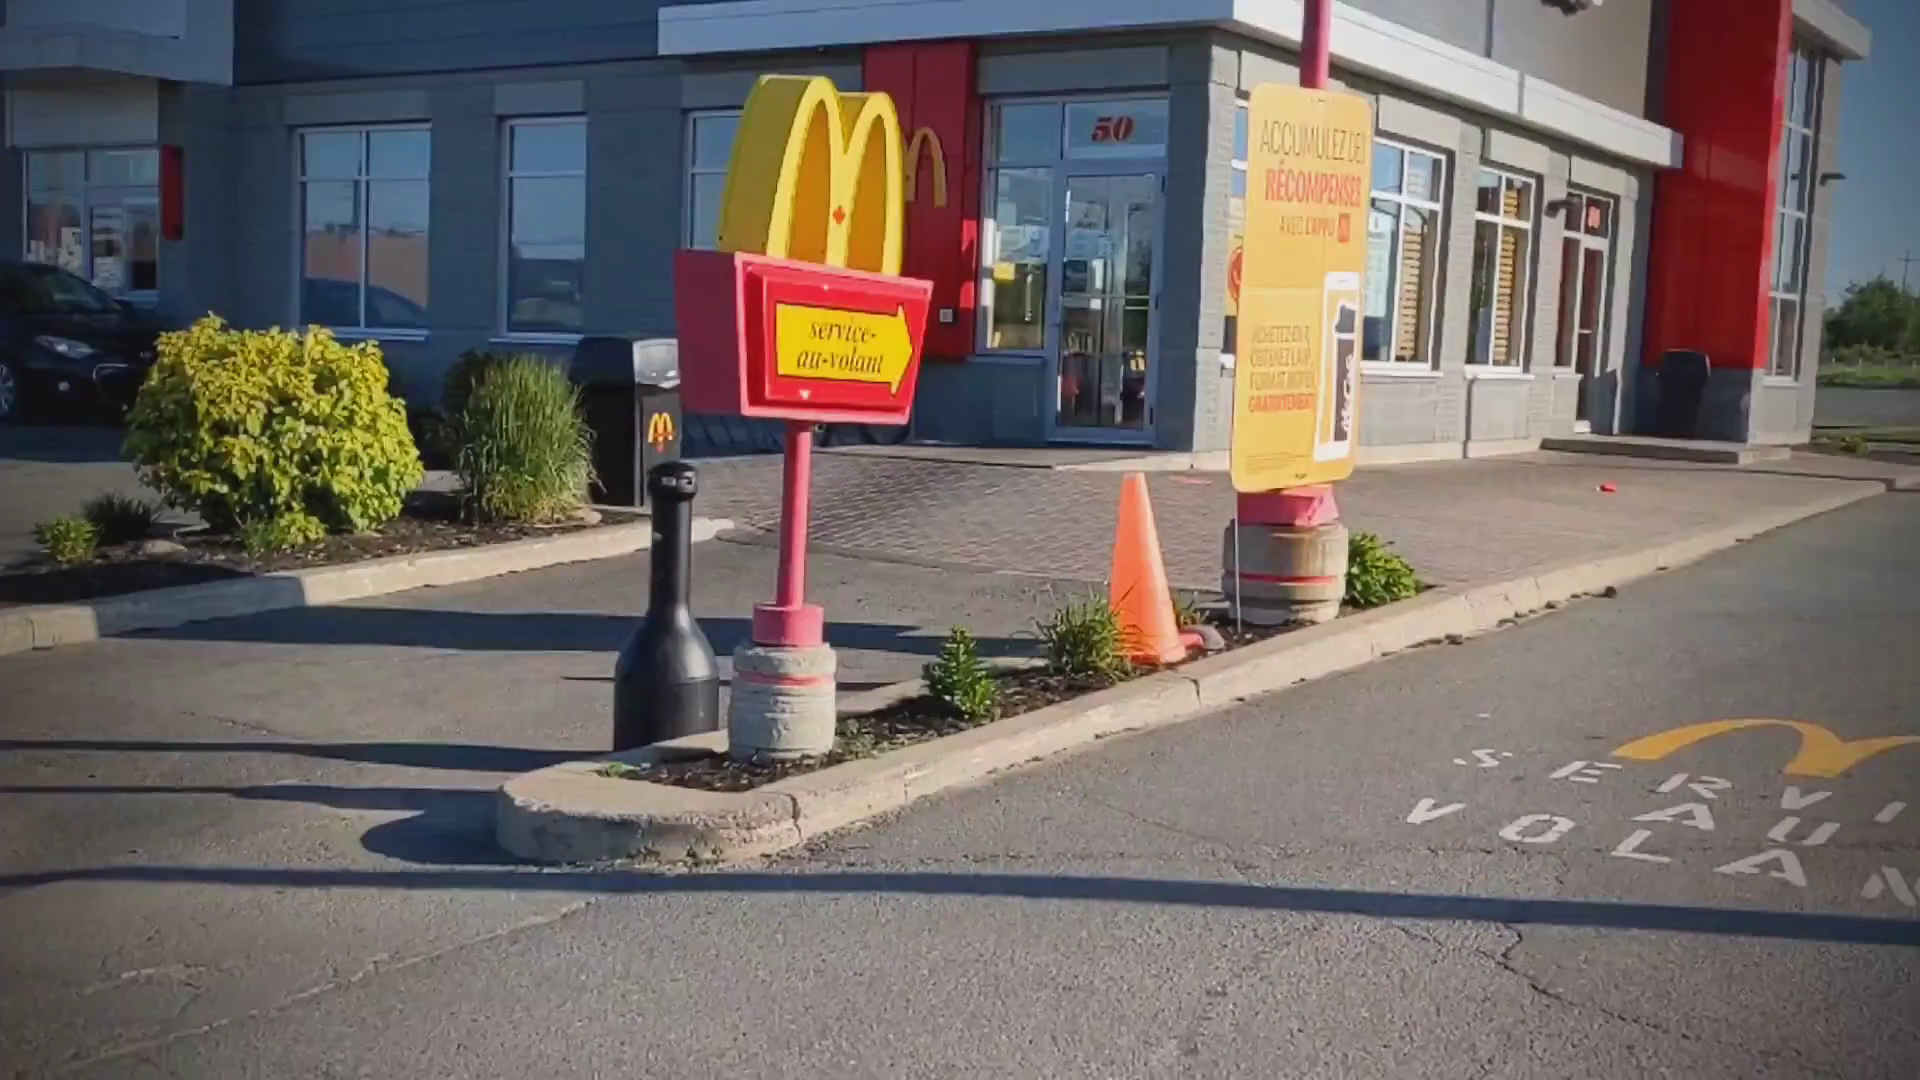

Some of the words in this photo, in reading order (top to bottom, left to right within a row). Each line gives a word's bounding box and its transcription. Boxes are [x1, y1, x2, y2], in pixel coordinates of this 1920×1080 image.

[1091, 115, 1134, 142] 50
[1259, 119, 1346, 161] ACCUMULEZ
[1264, 158, 1361, 207] RÉCOMPENSES
[796, 345, 884, 374] au-volant
[1631, 802, 1841, 847] AU
